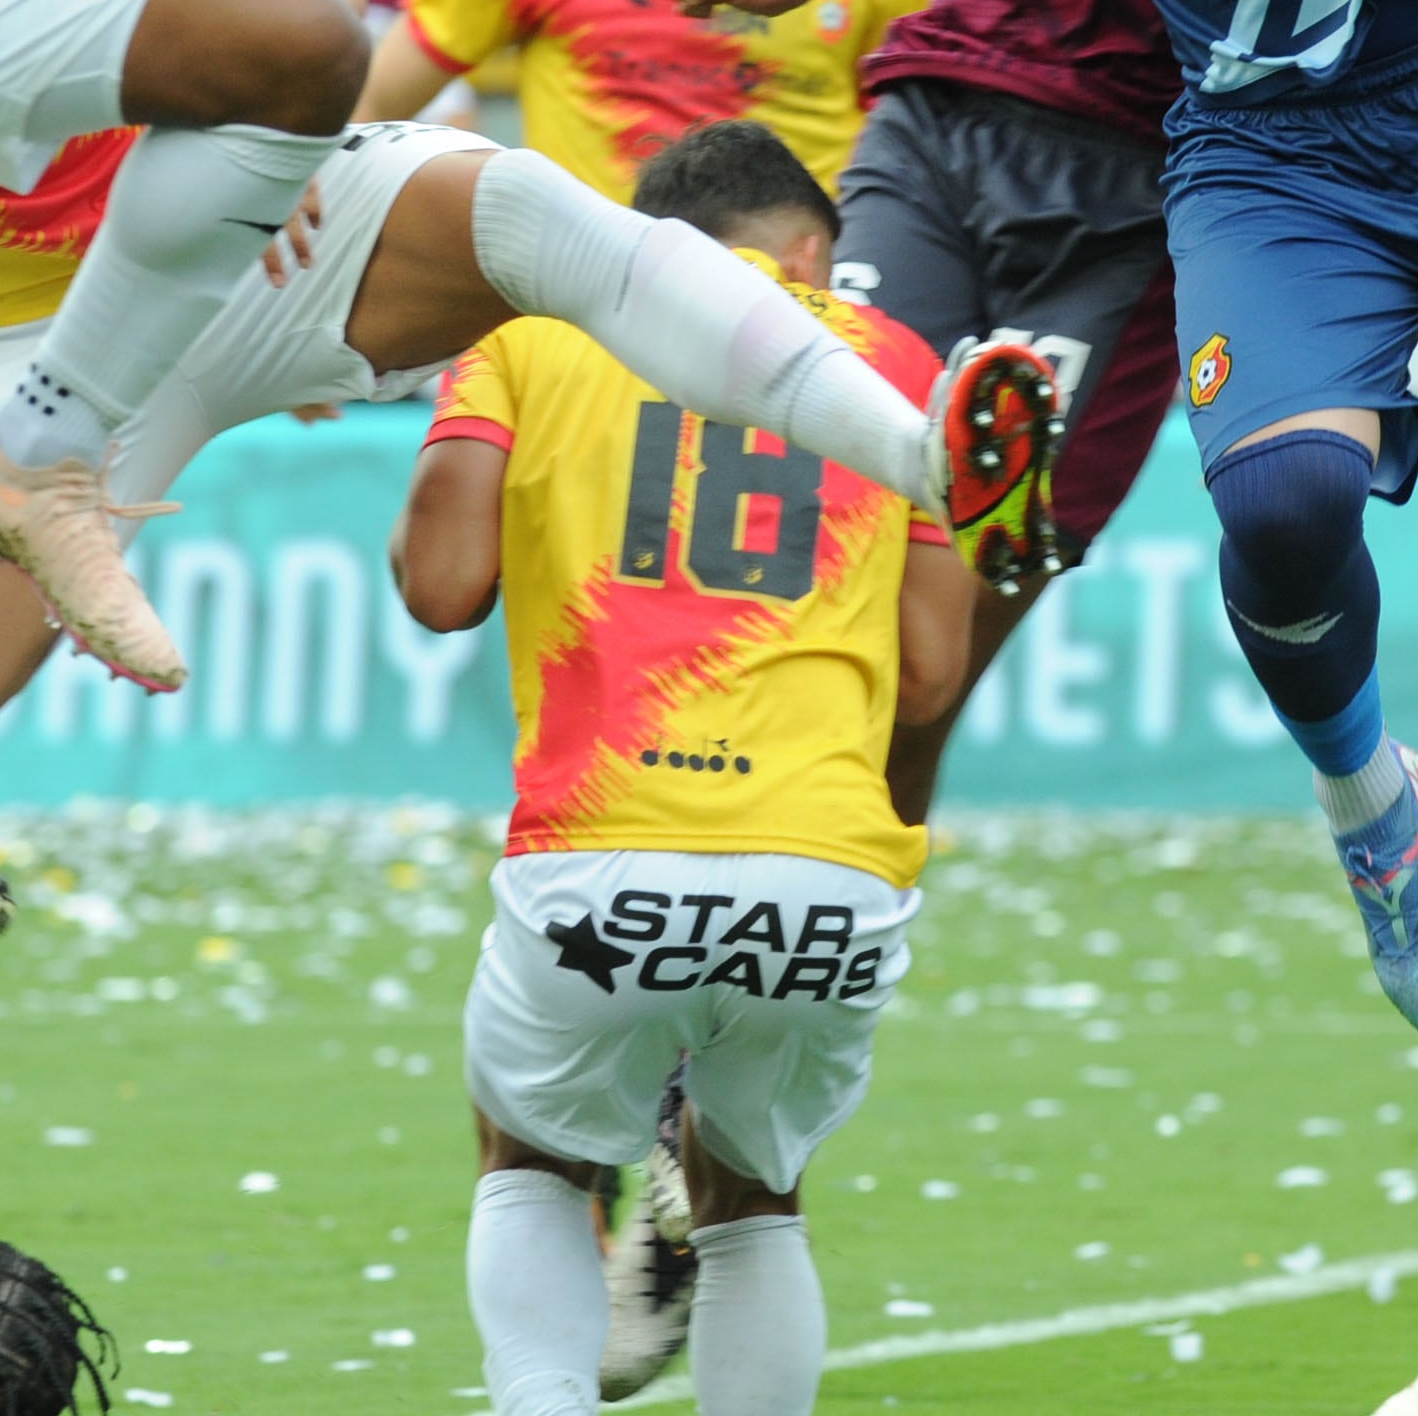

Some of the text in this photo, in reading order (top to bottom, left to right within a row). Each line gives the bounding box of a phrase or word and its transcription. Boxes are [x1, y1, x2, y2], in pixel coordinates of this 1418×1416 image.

[615, 399, 824, 603] 18
[603, 889, 854, 955] STAR
[637, 946, 883, 1003] CARS
